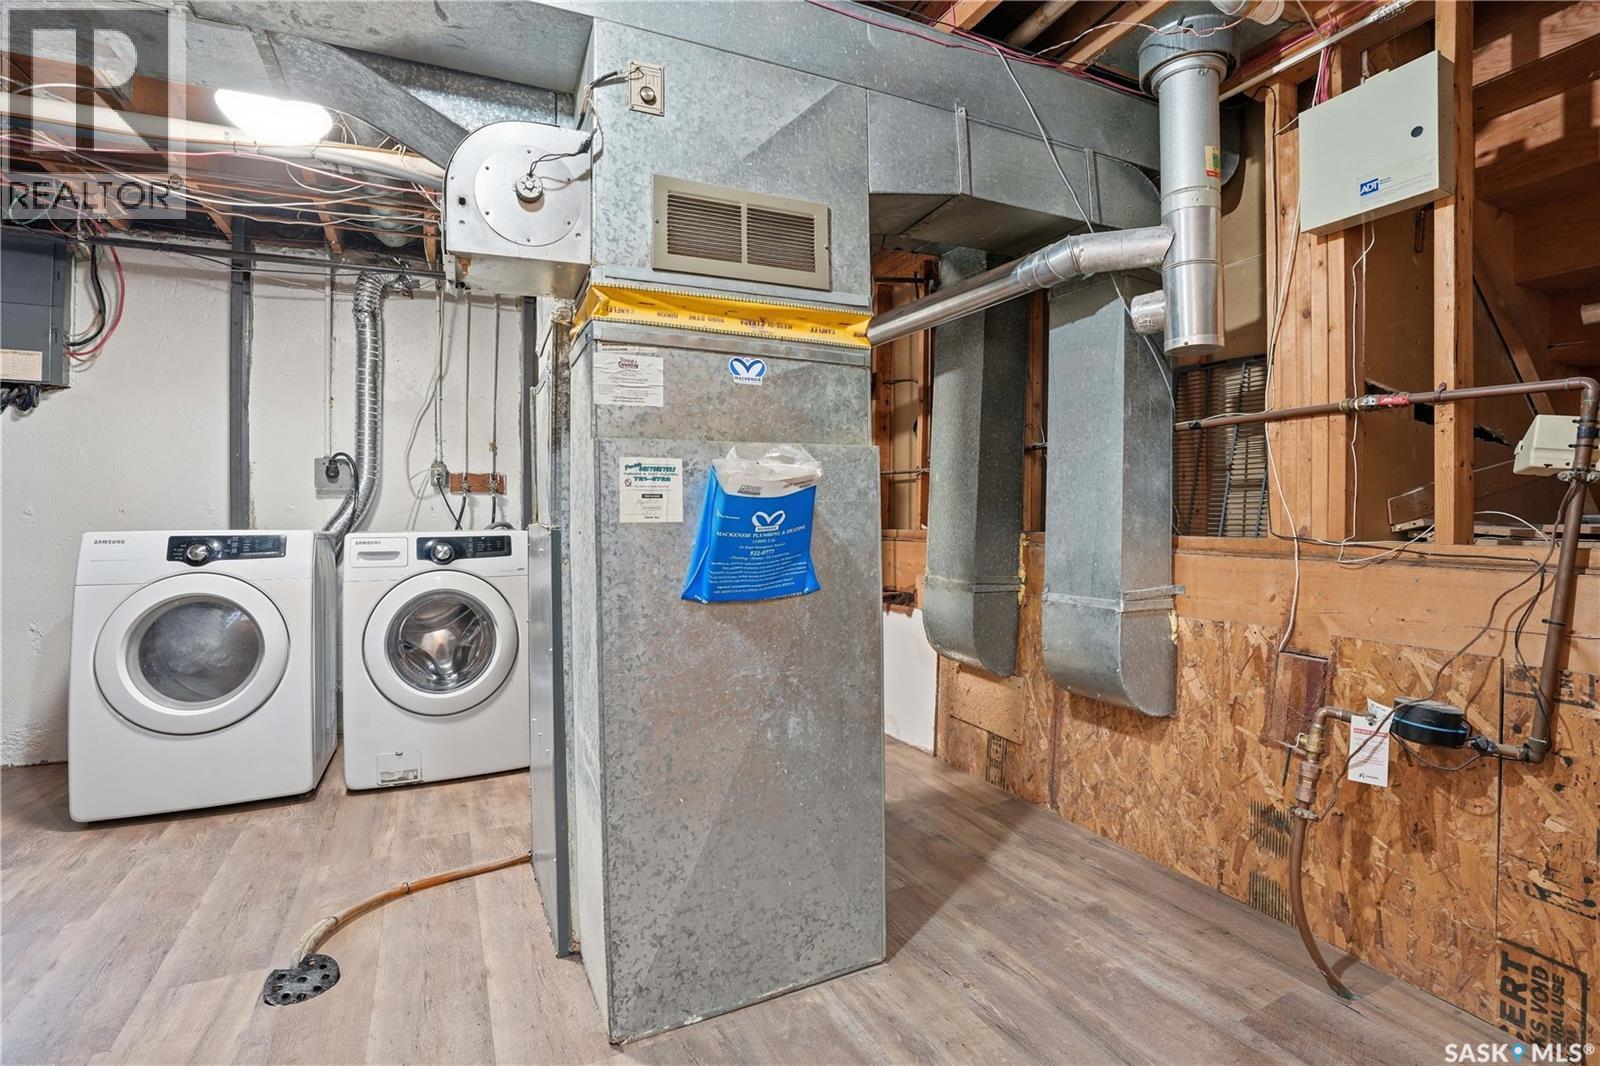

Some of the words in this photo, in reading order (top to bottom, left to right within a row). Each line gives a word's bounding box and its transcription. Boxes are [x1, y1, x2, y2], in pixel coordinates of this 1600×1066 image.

[1360, 181, 1378, 194] ADT
[752, 530, 781, 538] PLUMBING
[1530, 965, 1549, 1014] VOID
[1551, 972, 1565, 1006] USE
